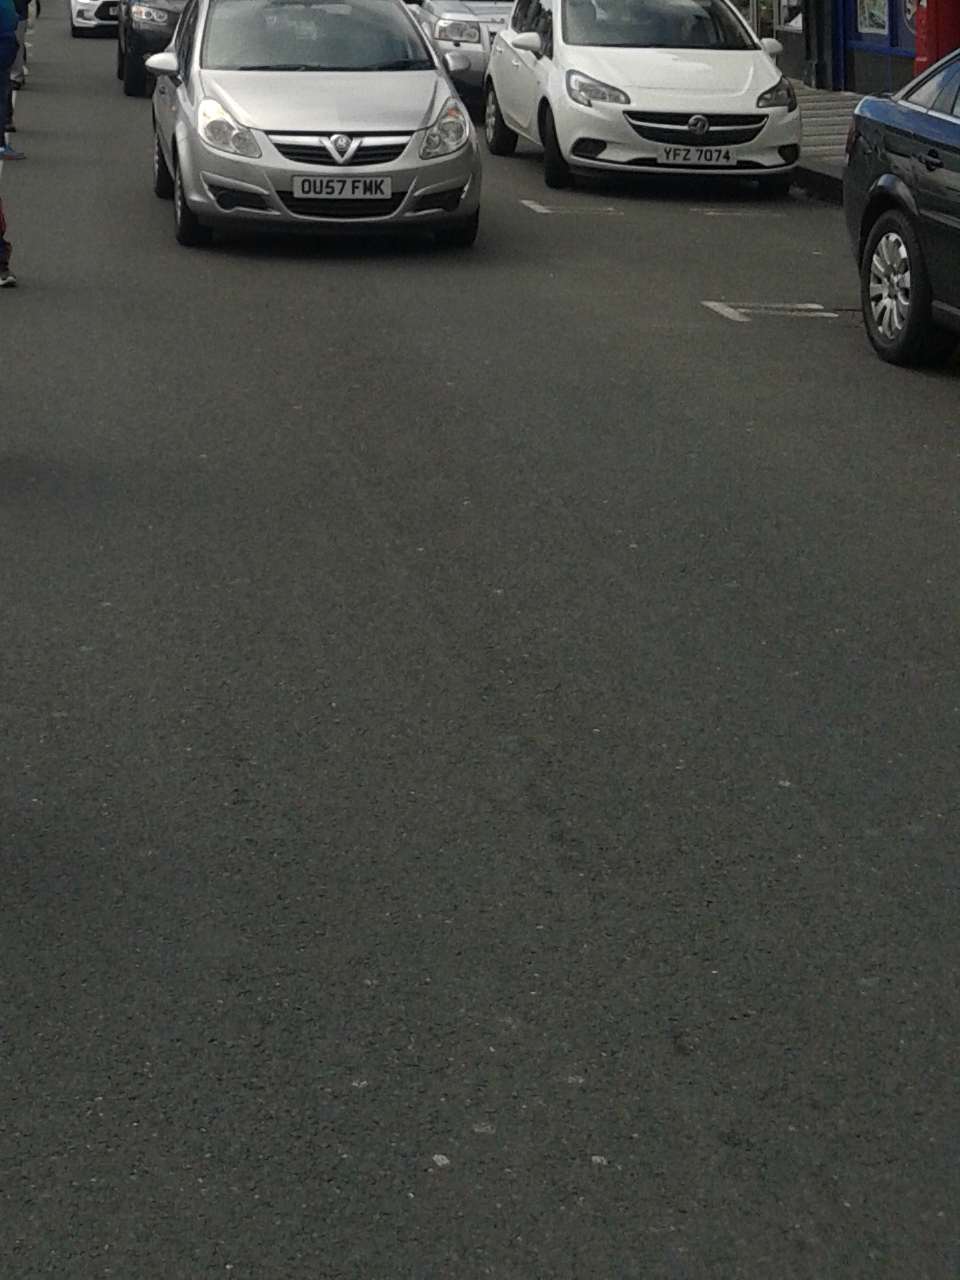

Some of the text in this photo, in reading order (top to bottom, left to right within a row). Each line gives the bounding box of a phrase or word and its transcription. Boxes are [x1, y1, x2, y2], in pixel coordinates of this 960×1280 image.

[663, 148, 731, 162] YFZ 7074
[301, 178, 385, 196] OU57 FMK
